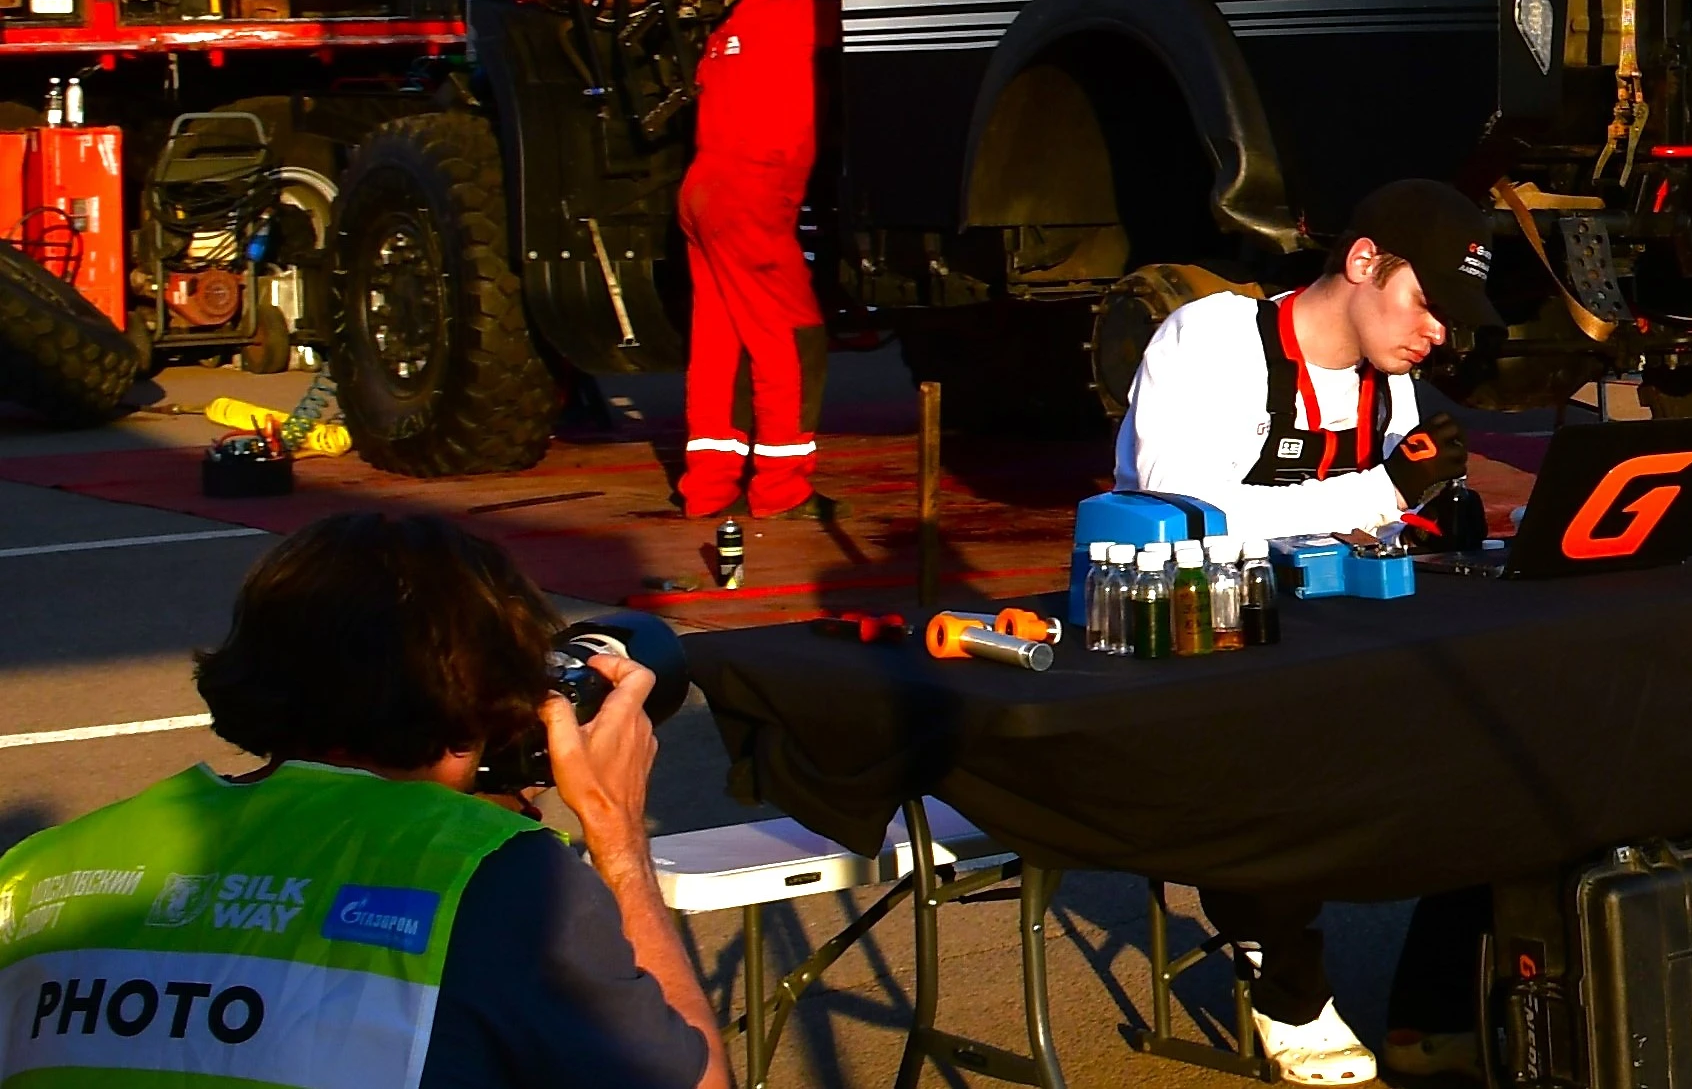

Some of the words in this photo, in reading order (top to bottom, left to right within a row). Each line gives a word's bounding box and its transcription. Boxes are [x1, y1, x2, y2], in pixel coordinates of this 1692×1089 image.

[218, 874, 312, 904] SILK
[212, 904, 303, 933] WAY
[30, 978, 265, 1044] PHOTO
